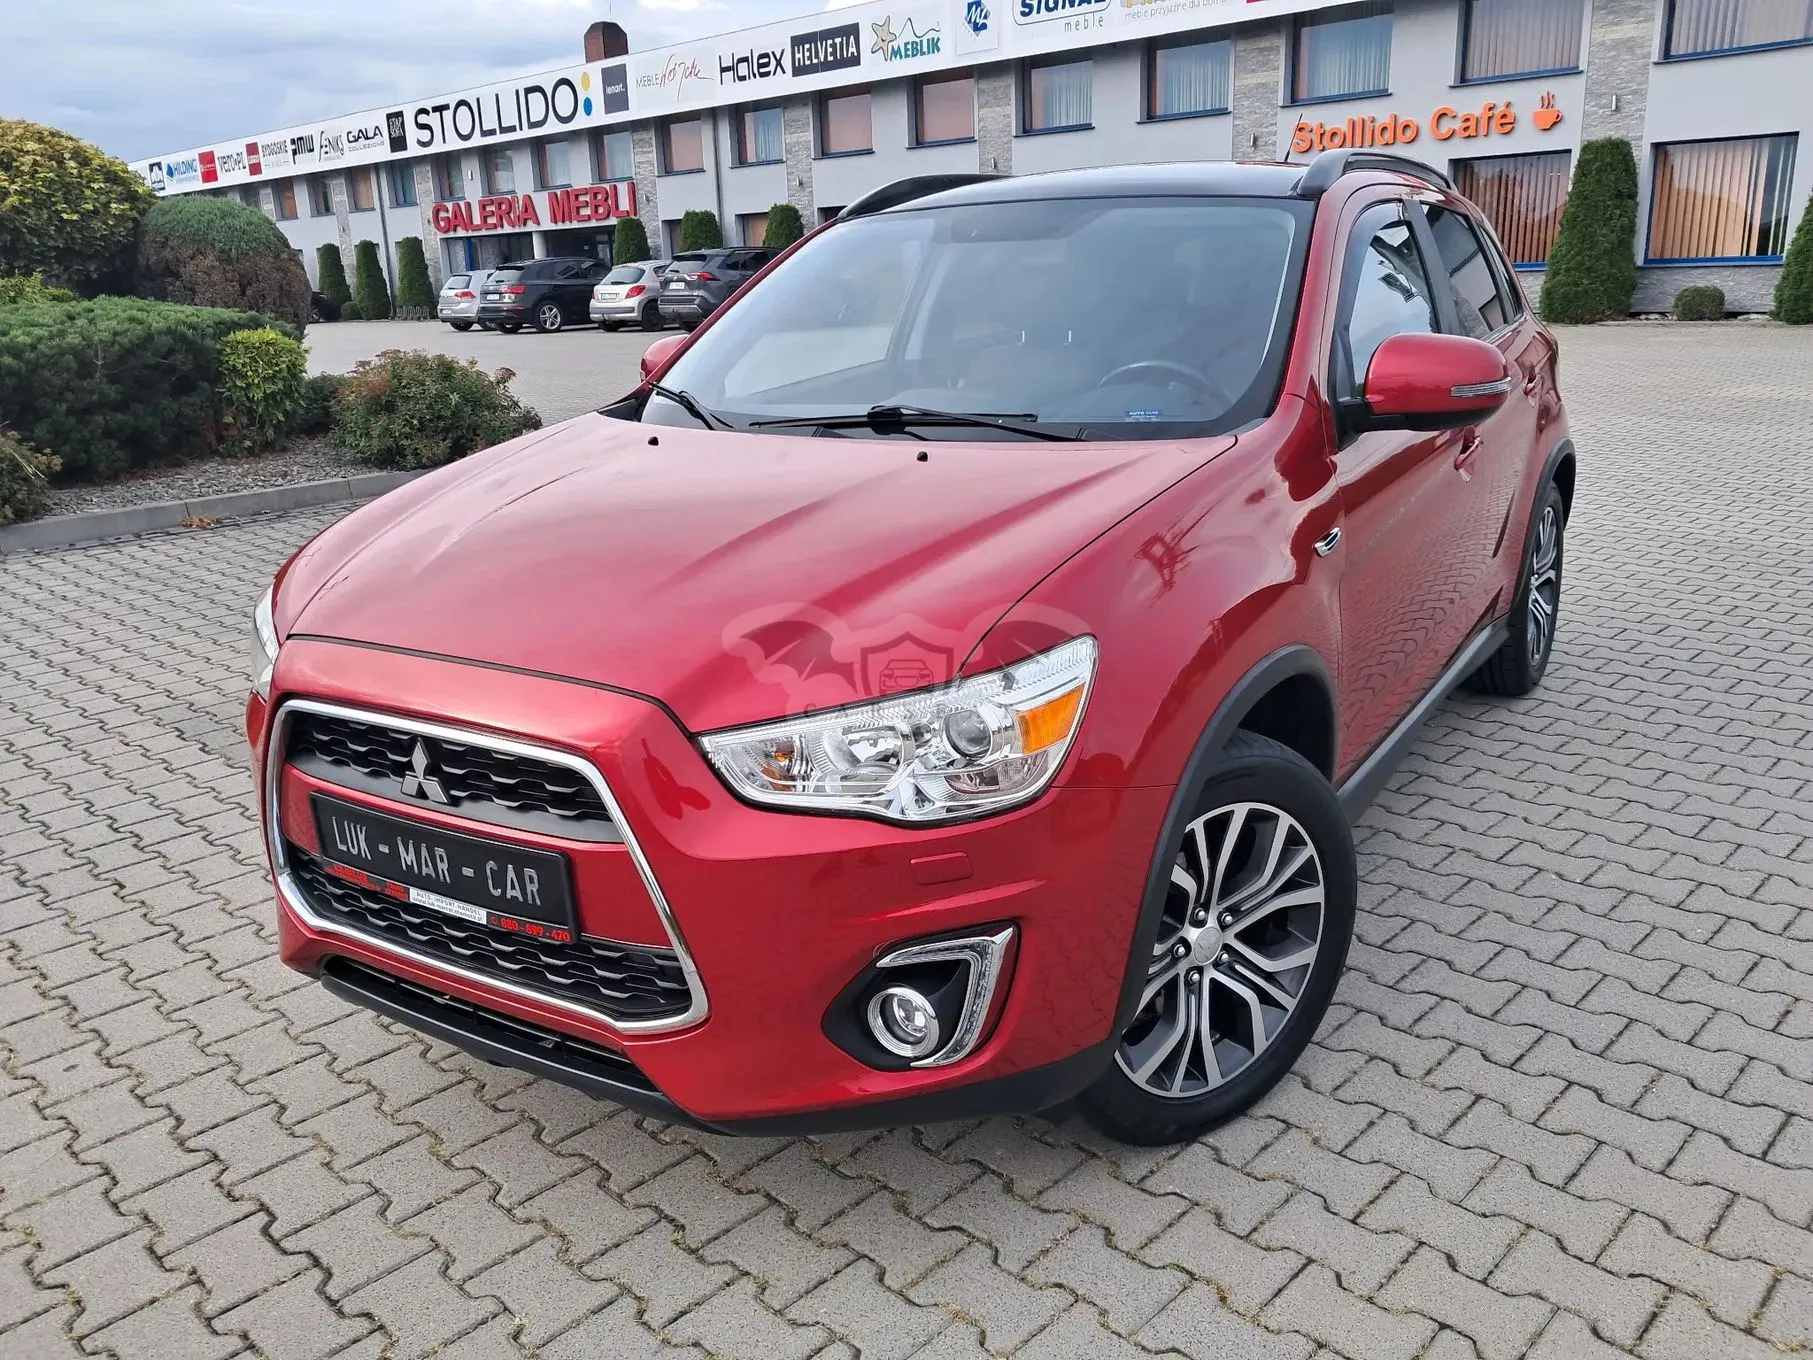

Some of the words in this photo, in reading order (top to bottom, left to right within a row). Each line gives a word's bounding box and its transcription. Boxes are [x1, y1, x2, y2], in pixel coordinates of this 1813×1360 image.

[1020, 0, 1106, 17] SIGN
[1065, 12, 1103, 32] meble
[794, 36, 857, 67] HELVETIA
[889, 36, 941, 61] MEBLIK
[719, 47, 786, 85] Halex
[636, 73, 659, 88] MEBLE
[414, 77, 578, 148] STOLLIDO
[1292, 113, 1419, 153] Stollido
[1430, 100, 1516, 140] Café
[347, 126, 383, 143] GALA
[173, 159, 197, 175] HILDING
[431, 193, 540, 234] GALERIA
[548, 181, 637, 224] MEBLI
[331, 816, 371, 860] LUK
[397, 837, 451, 884] MAR
[485, 860, 541, 906] CAR
